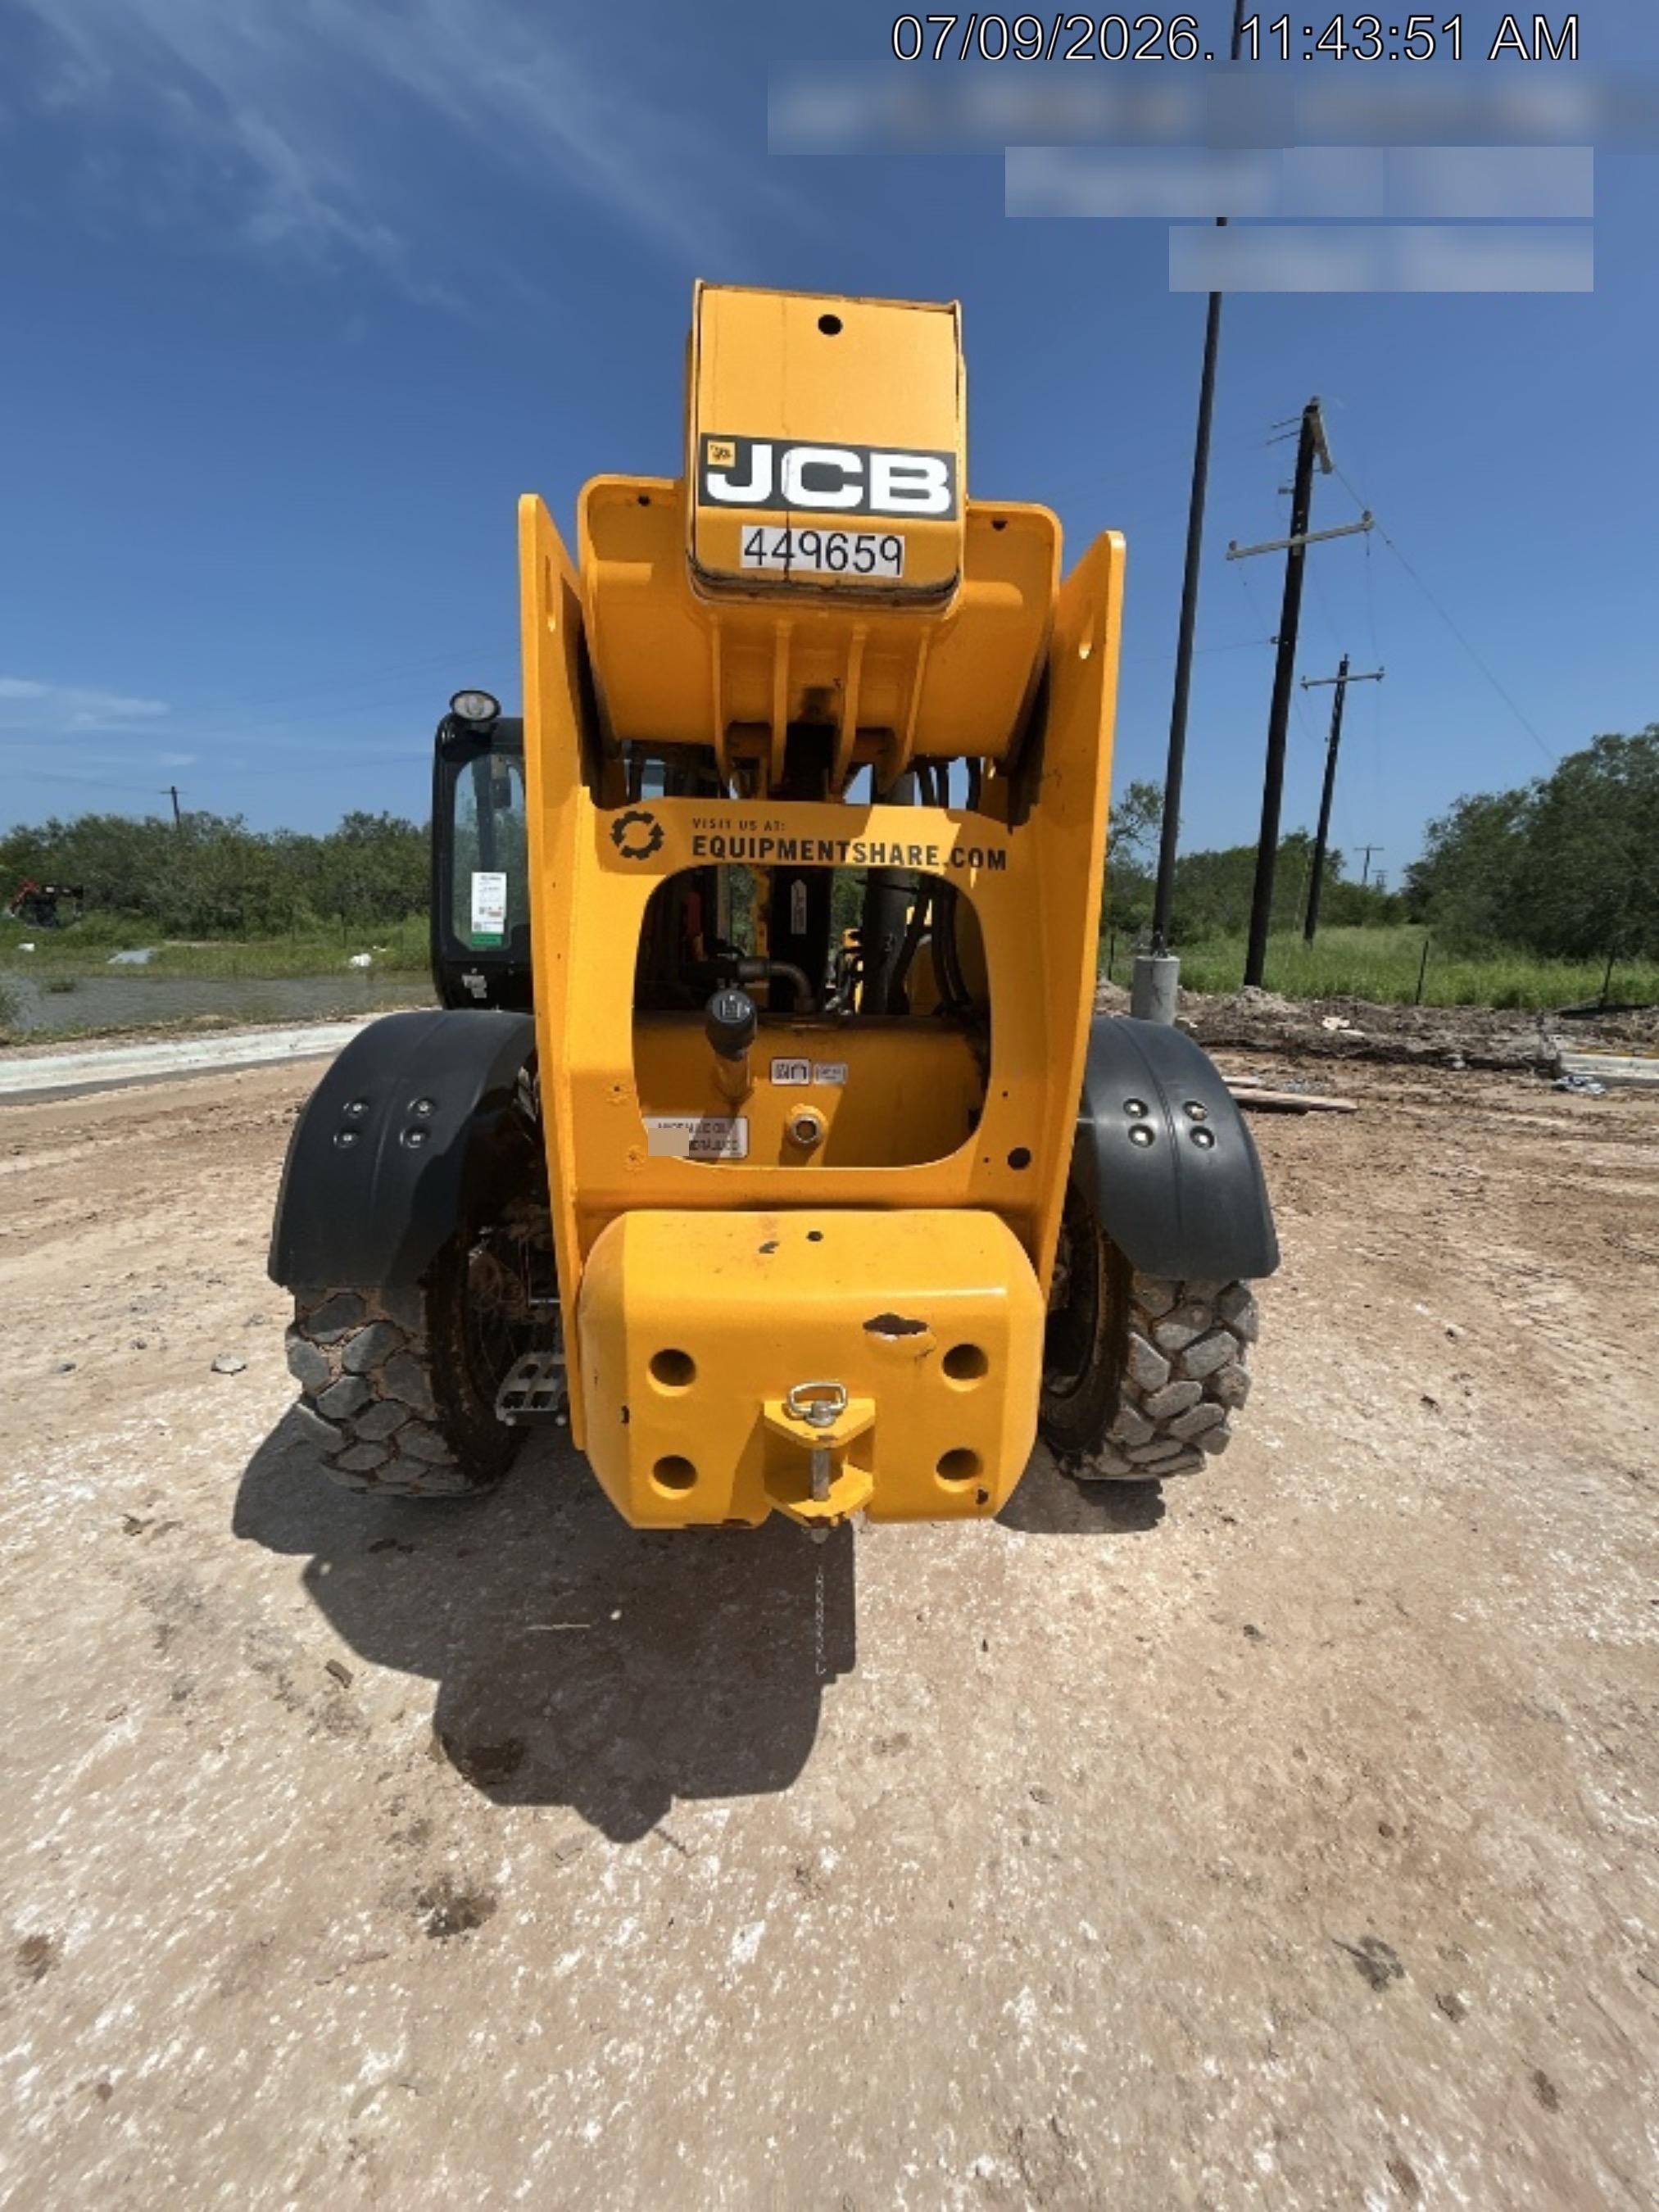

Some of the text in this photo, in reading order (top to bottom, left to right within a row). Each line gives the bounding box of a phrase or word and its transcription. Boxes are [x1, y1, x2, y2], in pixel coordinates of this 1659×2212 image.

[707, 444, 951, 513] JCB
[744, 528, 902, 575] 449659
[693, 818, 786, 832] VISIT US AT:
[692, 836, 1006, 870] EQUIPMENTSHARE.COM
